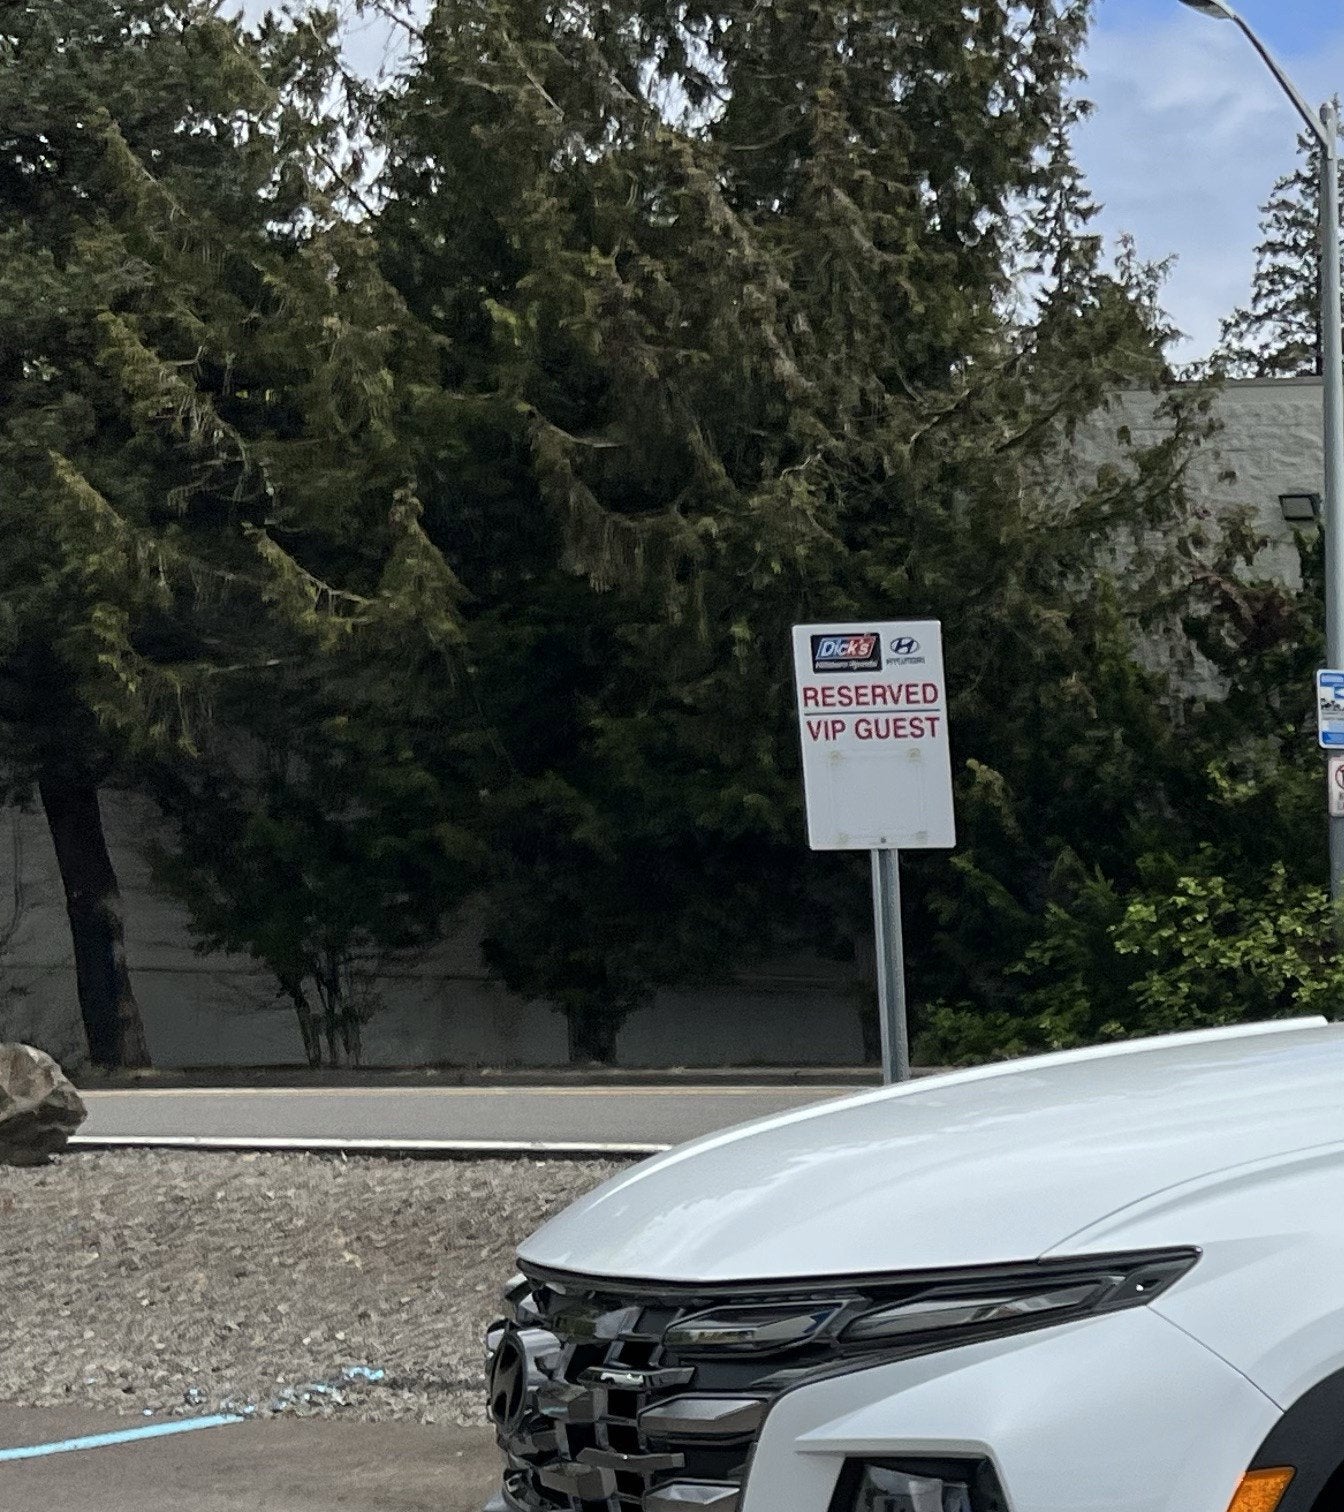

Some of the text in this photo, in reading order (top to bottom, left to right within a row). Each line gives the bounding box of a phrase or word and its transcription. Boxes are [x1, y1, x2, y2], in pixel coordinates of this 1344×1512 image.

[803, 682, 939, 708] RESERVED
[806, 717, 941, 741] VIP GUEST
